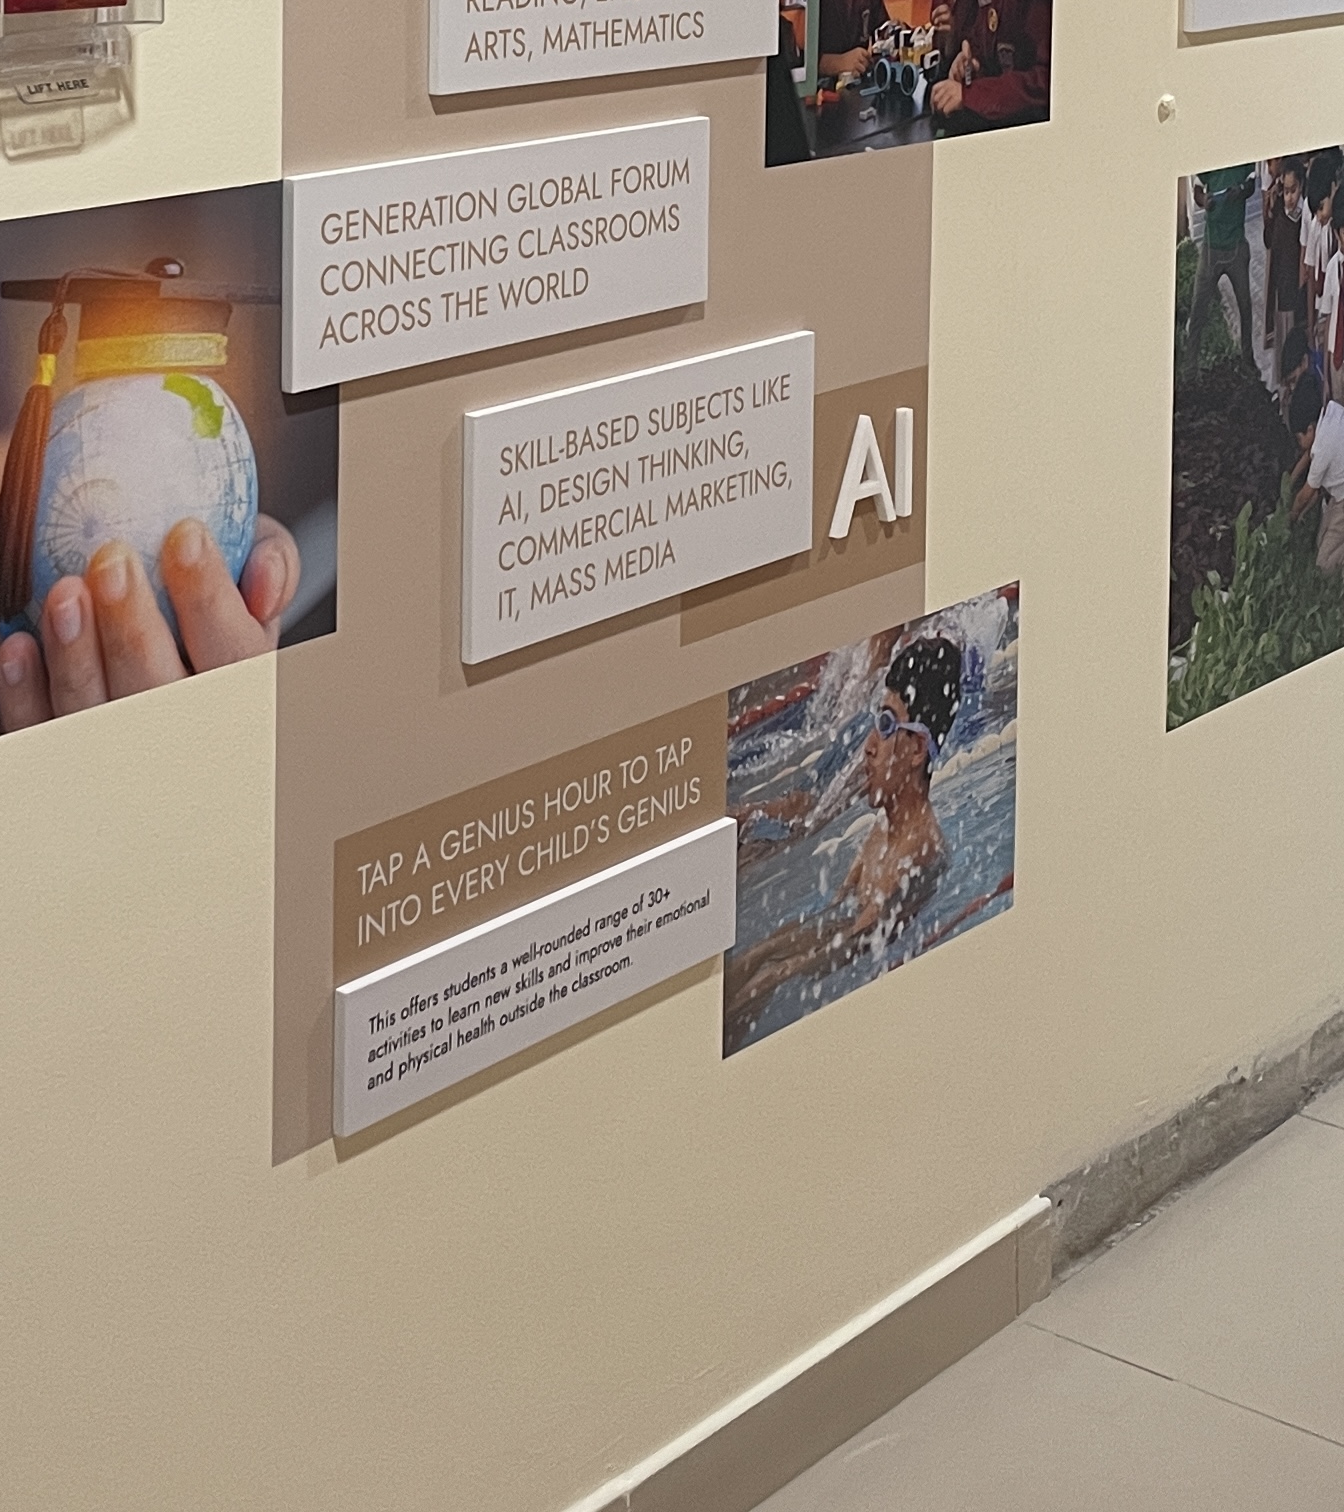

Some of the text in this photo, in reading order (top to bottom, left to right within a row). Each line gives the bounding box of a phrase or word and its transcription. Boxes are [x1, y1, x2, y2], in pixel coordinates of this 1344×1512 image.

[463, 10, 704, 63] ARTS, MATHEMATICS
[26, 78, 90, 95] LIFT HERE
[320, 156, 690, 245] GENERATION GLOBAL FORUM
[319, 203, 680, 296] CONNECTING CLASSROOMS
[318, 266, 589, 350] ACROSS THE WORLD
[499, 372, 791, 476] SKILL-BASED SUBJECTS LIKE
[497, 430, 749, 526] AI, DESIGN THINKING,
[498, 460, 792, 571] COMMERCIAL MARKETING,
[827, 405, 914, 540] AI
[498, 539, 676, 622] IT, MASS MEDIA
[356, 736, 692, 896] TAP A GENIUS HOUR TO TAP
[358, 777, 700, 947] INTO EVERY CHILD'S GENIUS
[367, 887, 671, 1035] This offers students a well-rounded range of 30+
